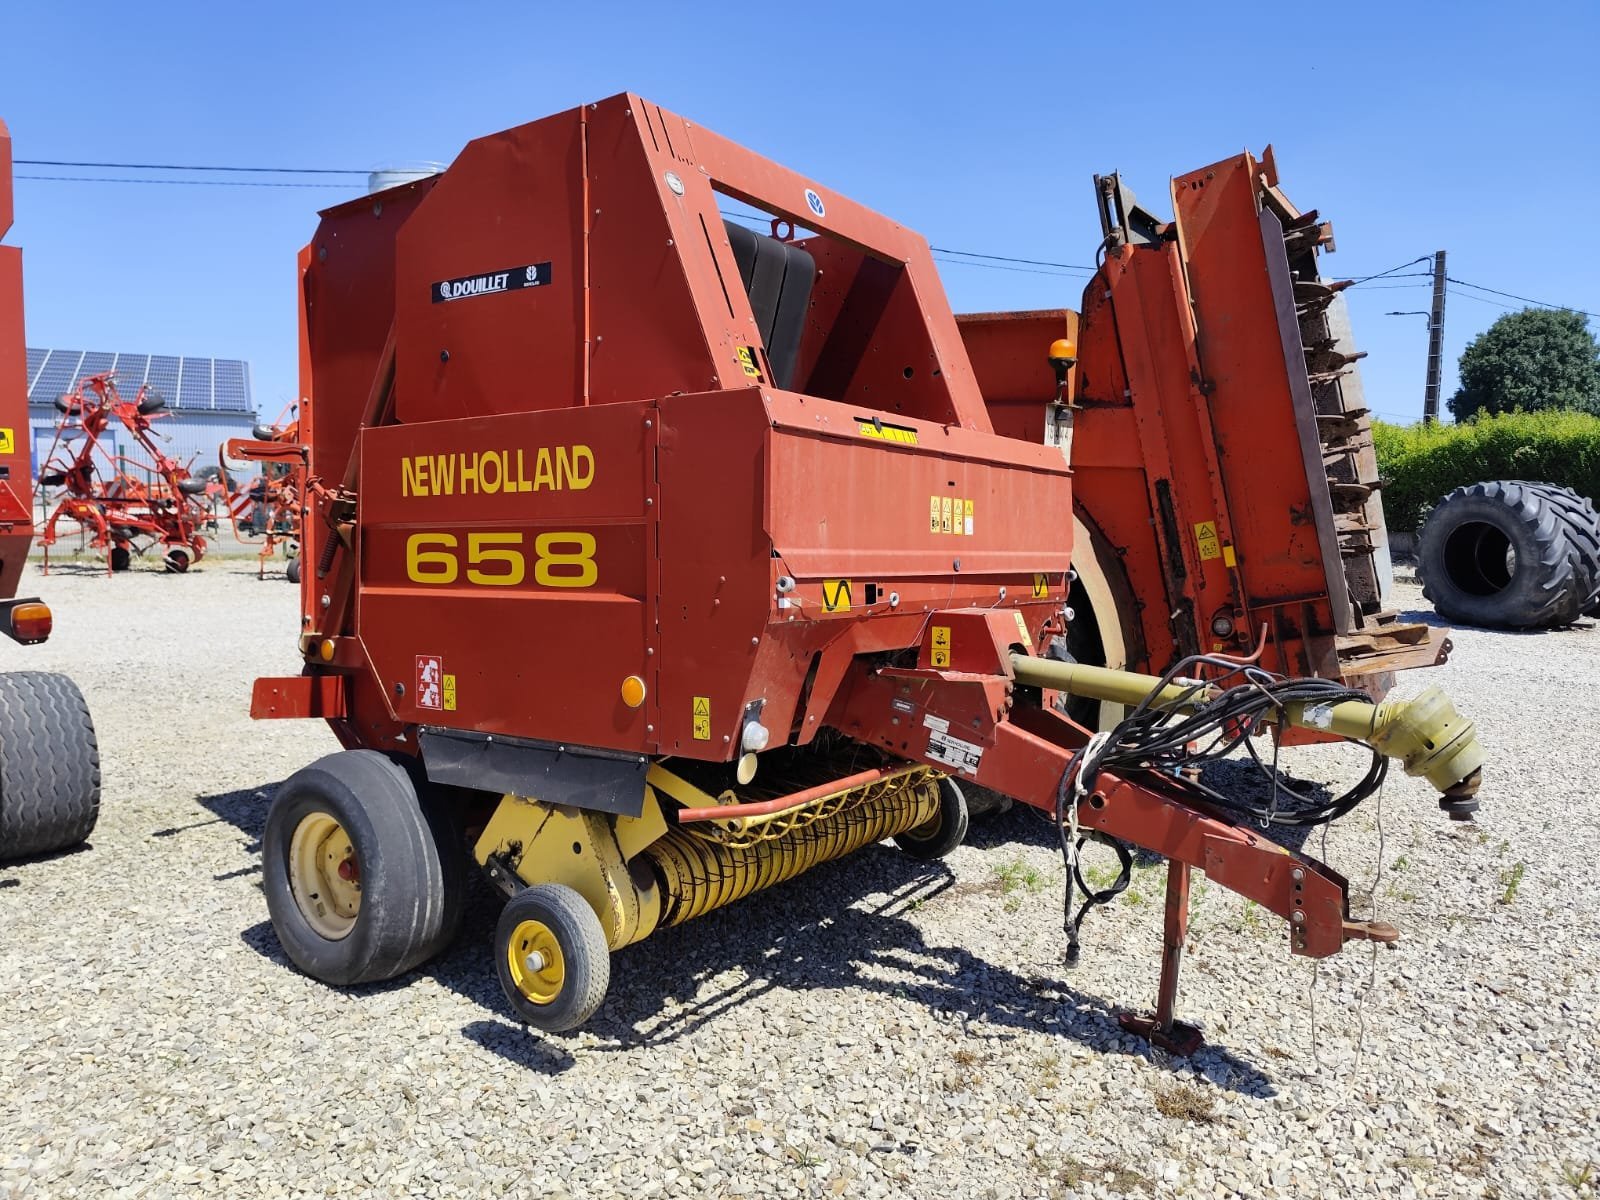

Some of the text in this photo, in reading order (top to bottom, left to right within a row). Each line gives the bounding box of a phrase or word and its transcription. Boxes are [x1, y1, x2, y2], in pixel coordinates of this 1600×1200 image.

[453, 273, 510, 297] DOUILLET
[402, 445, 595, 497] NEW HOLLAND
[406, 532, 598, 587] 658
